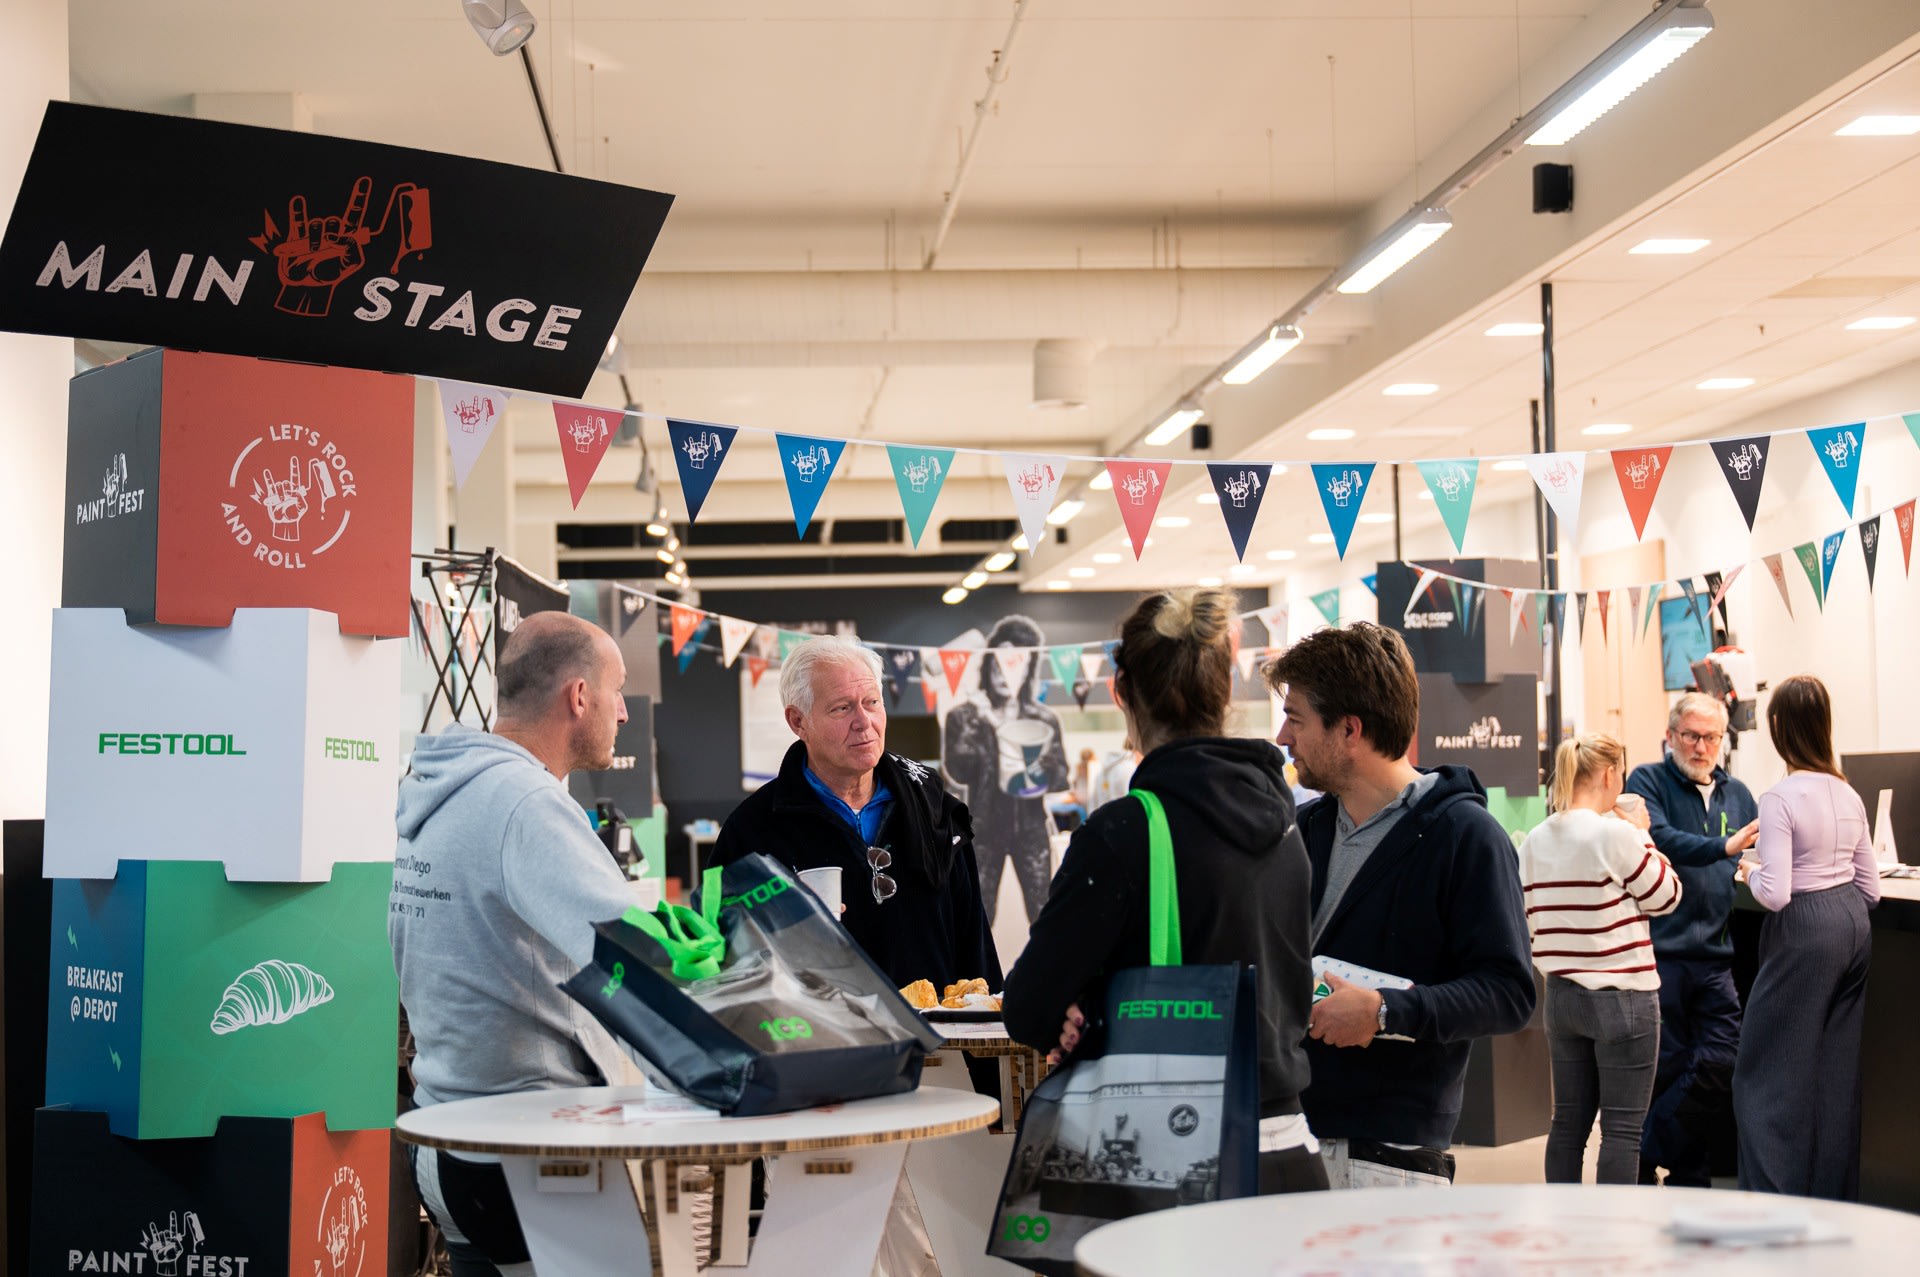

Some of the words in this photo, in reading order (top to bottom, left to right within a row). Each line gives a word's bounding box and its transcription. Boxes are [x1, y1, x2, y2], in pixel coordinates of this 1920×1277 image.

[35, 240, 254, 305] MAIN
[353, 277, 582, 351] STAGE
[269, 424, 321, 447] LET'S
[321, 441, 356, 498] ROCK
[76, 497, 105, 525] PAINT
[118, 488, 145, 516] FEST
[221, 502, 253, 547] AND
[253, 543, 306, 569] ROLL
[99, 733, 247, 756] FESTOOL
[325, 737, 380, 762] FESTOOL
[1435, 735, 1474, 749] PAINT
[1490, 735, 1522, 749] FEST
[613, 756, 636, 769] EST
[67, 966, 123, 994] BREAKFAST
[70, 996, 81, 1022] @
[84, 1000, 118, 1023] DEPOT
[1117, 1000, 1223, 1020] FESTOOL
[759, 1015, 813, 1041] 100
[334, 1166, 355, 1187] LET'S
[354, 1175, 368, 1229] ROCK
[68, 1249, 147, 1274] PAINT
[186, 1254, 249, 1277] FEST
